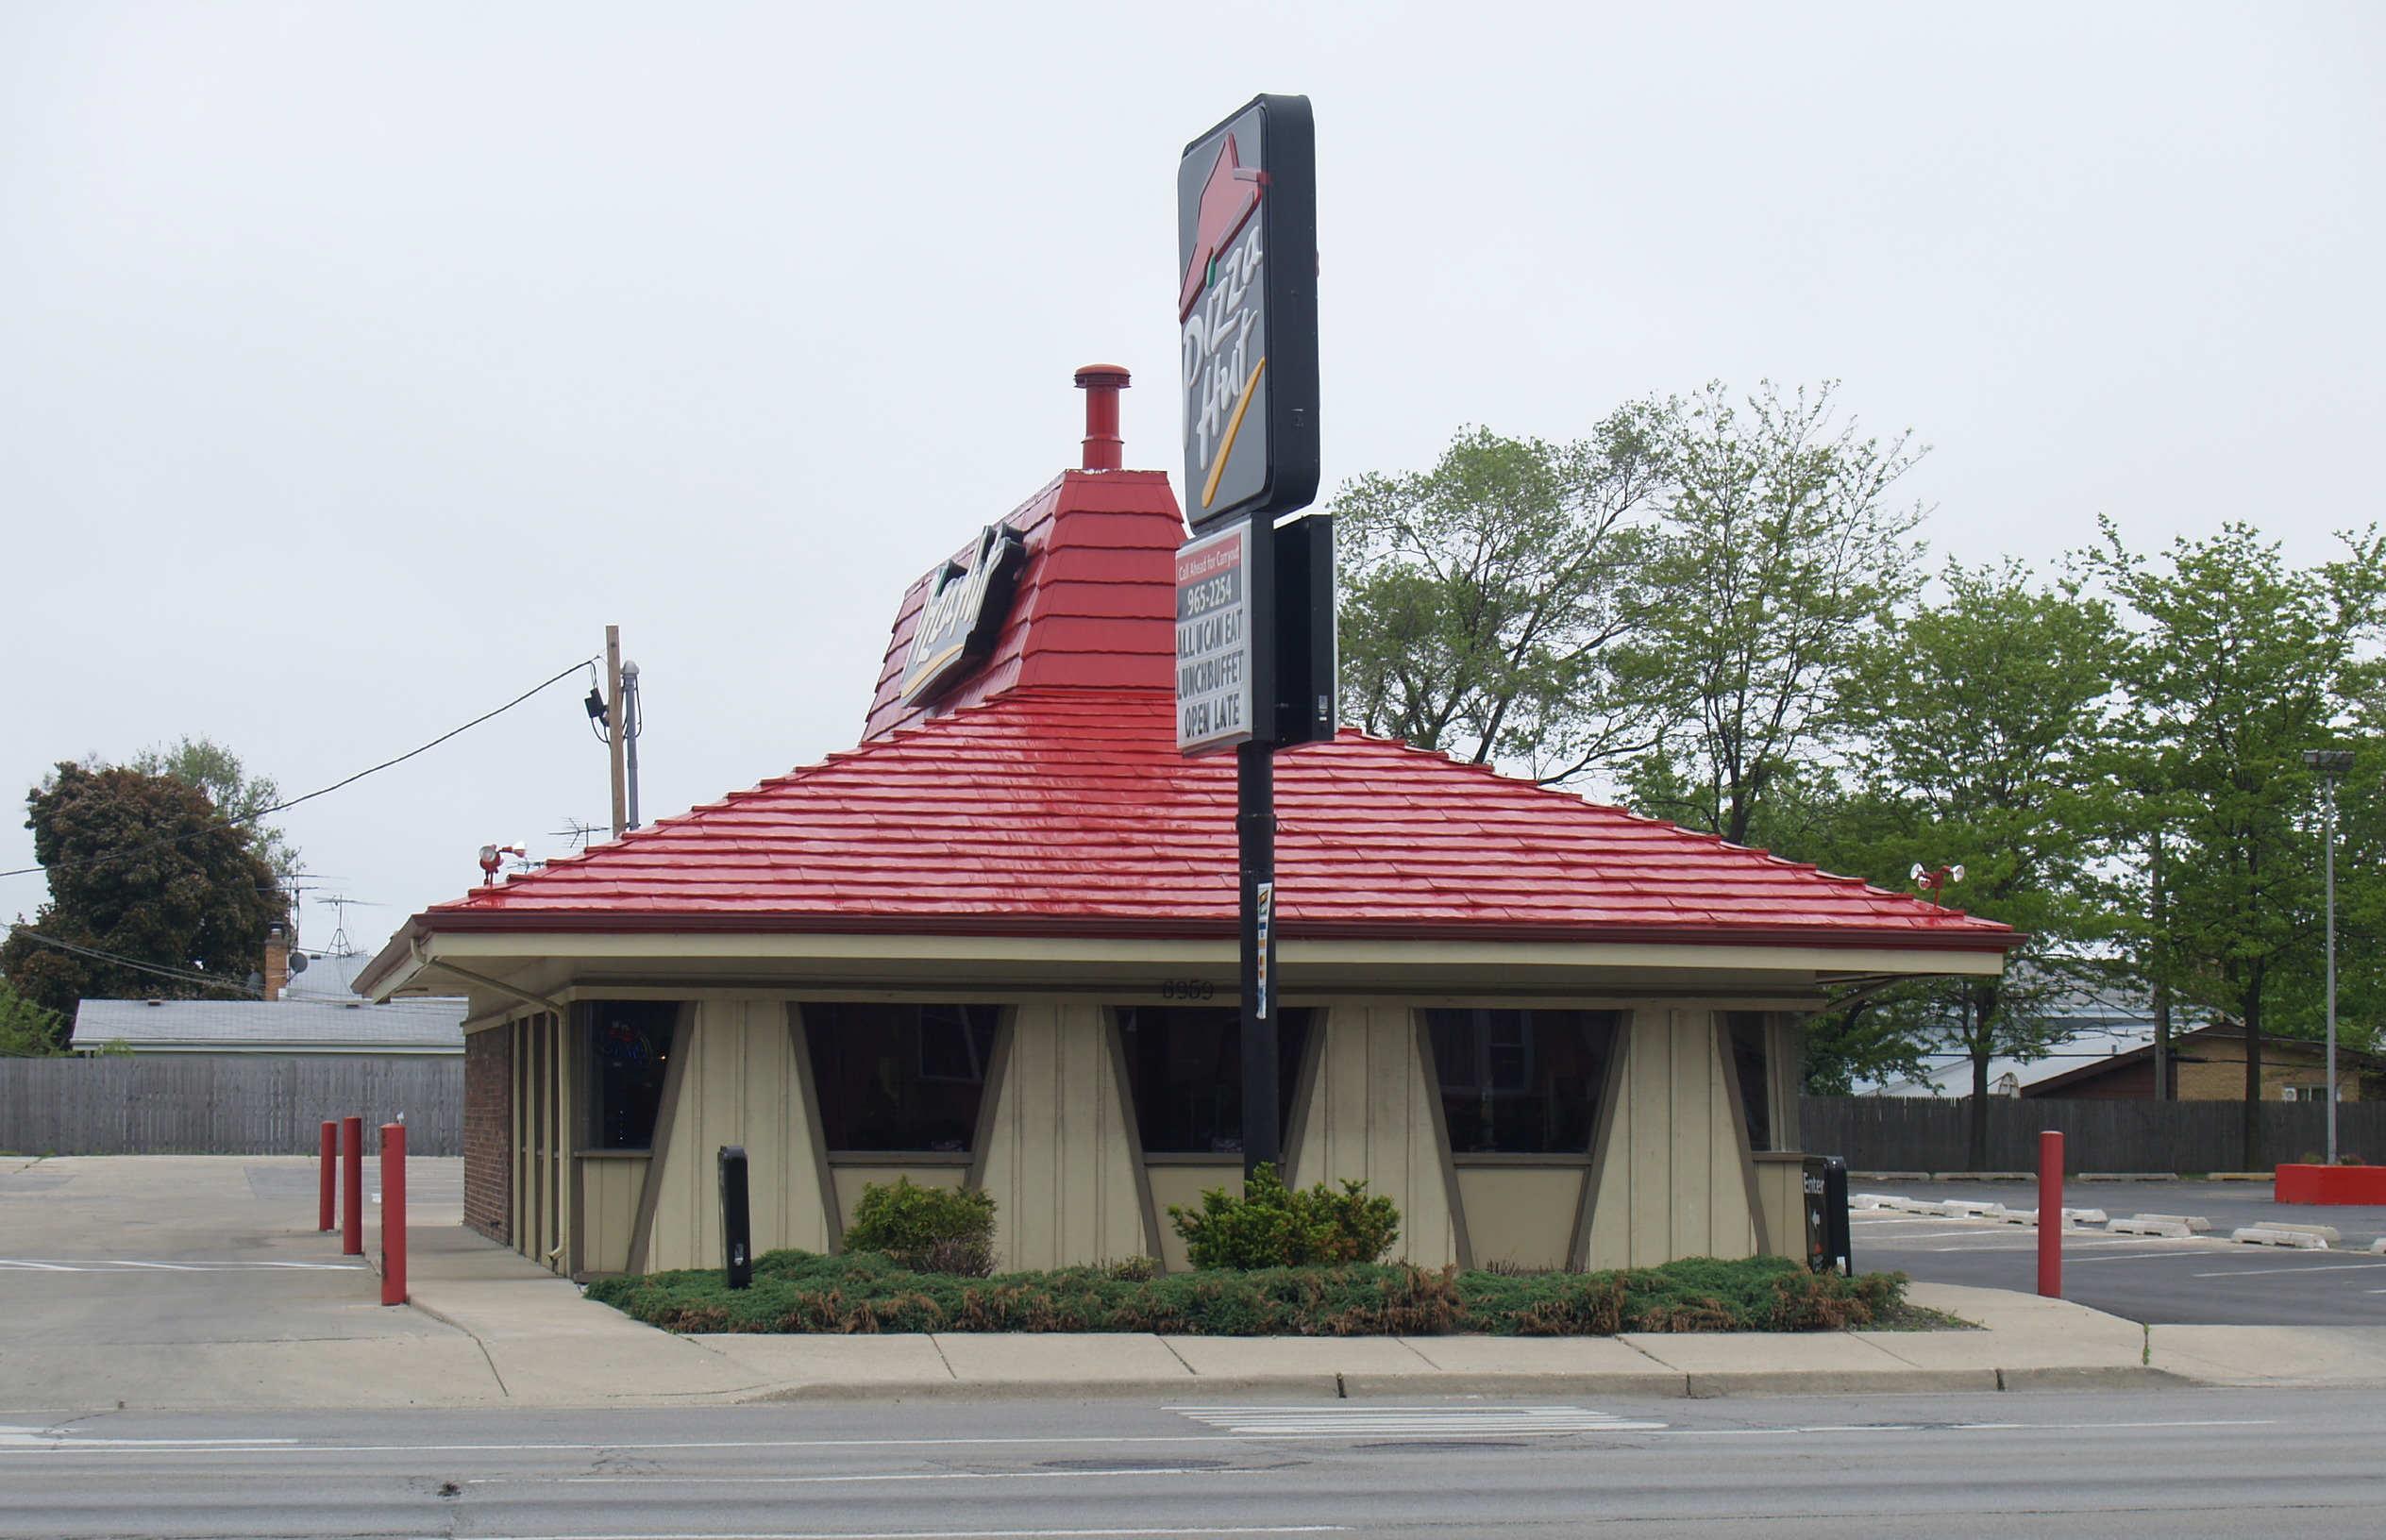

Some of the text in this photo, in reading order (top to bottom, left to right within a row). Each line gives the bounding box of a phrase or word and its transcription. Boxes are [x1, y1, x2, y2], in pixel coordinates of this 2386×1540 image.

[1183, 226, 1264, 449] Pizza
[1197, 309, 1258, 470] Hut
[1178, 561, 1190, 581] Call
[1186, 573, 1232, 617] 965-2254
[1177, 608, 1243, 661] ALL U CAN EAT
[1185, 693, 1239, 738] OPEN LATE
[1804, 1171, 1825, 1195] Enter
